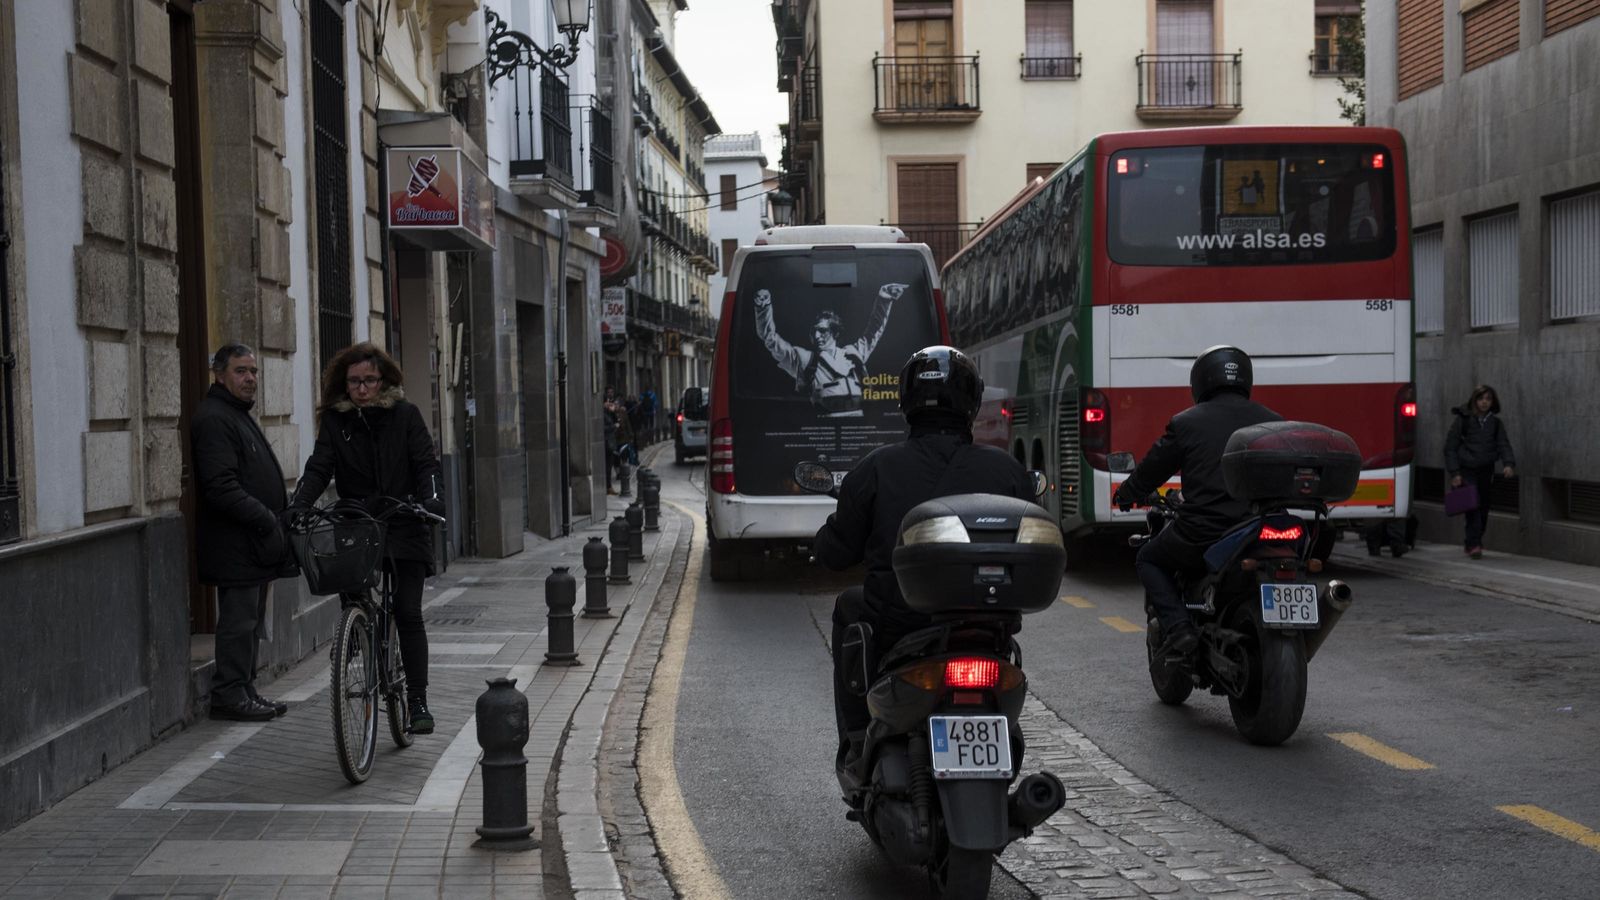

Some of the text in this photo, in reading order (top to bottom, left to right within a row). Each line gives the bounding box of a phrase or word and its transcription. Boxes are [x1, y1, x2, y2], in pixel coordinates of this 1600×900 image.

[1111, 304, 1140, 316] 5581
[1365, 299, 1393, 311] 5581
[862, 373, 900, 386] colita
[1272, 588, 1314, 603] 3803
[1279, 604, 1310, 620] DFG
[949, 721, 1000, 742] 4881
[957, 744, 999, 766] FCD
